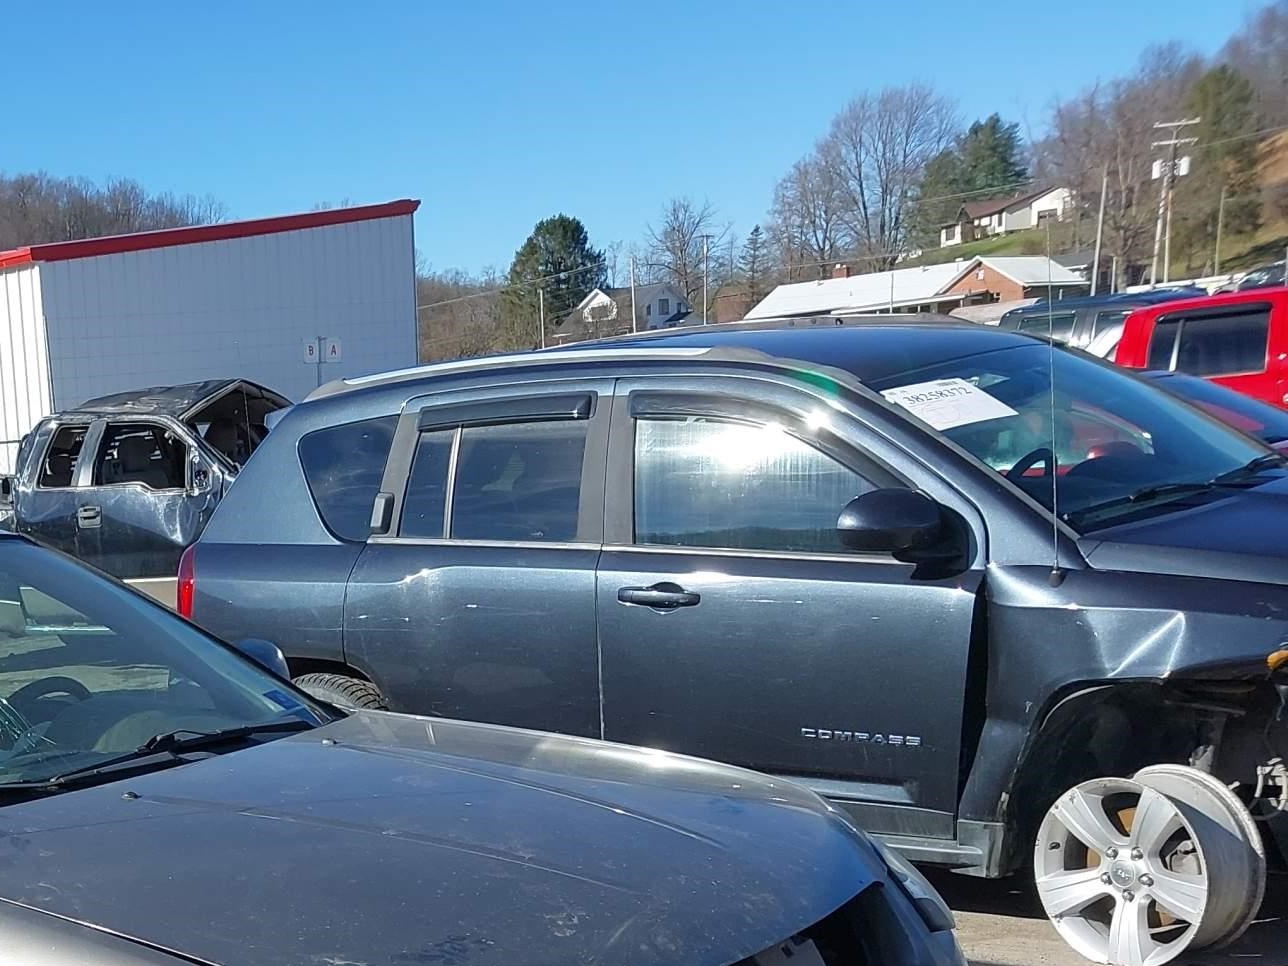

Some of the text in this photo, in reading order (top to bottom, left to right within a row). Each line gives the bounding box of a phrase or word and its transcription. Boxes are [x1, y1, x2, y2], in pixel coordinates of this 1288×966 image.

[308, 345, 314, 356] B
[330, 344, 337, 356] A
[903, 386, 973, 405] 38258372
[800, 727, 921, 746] COMPASS
